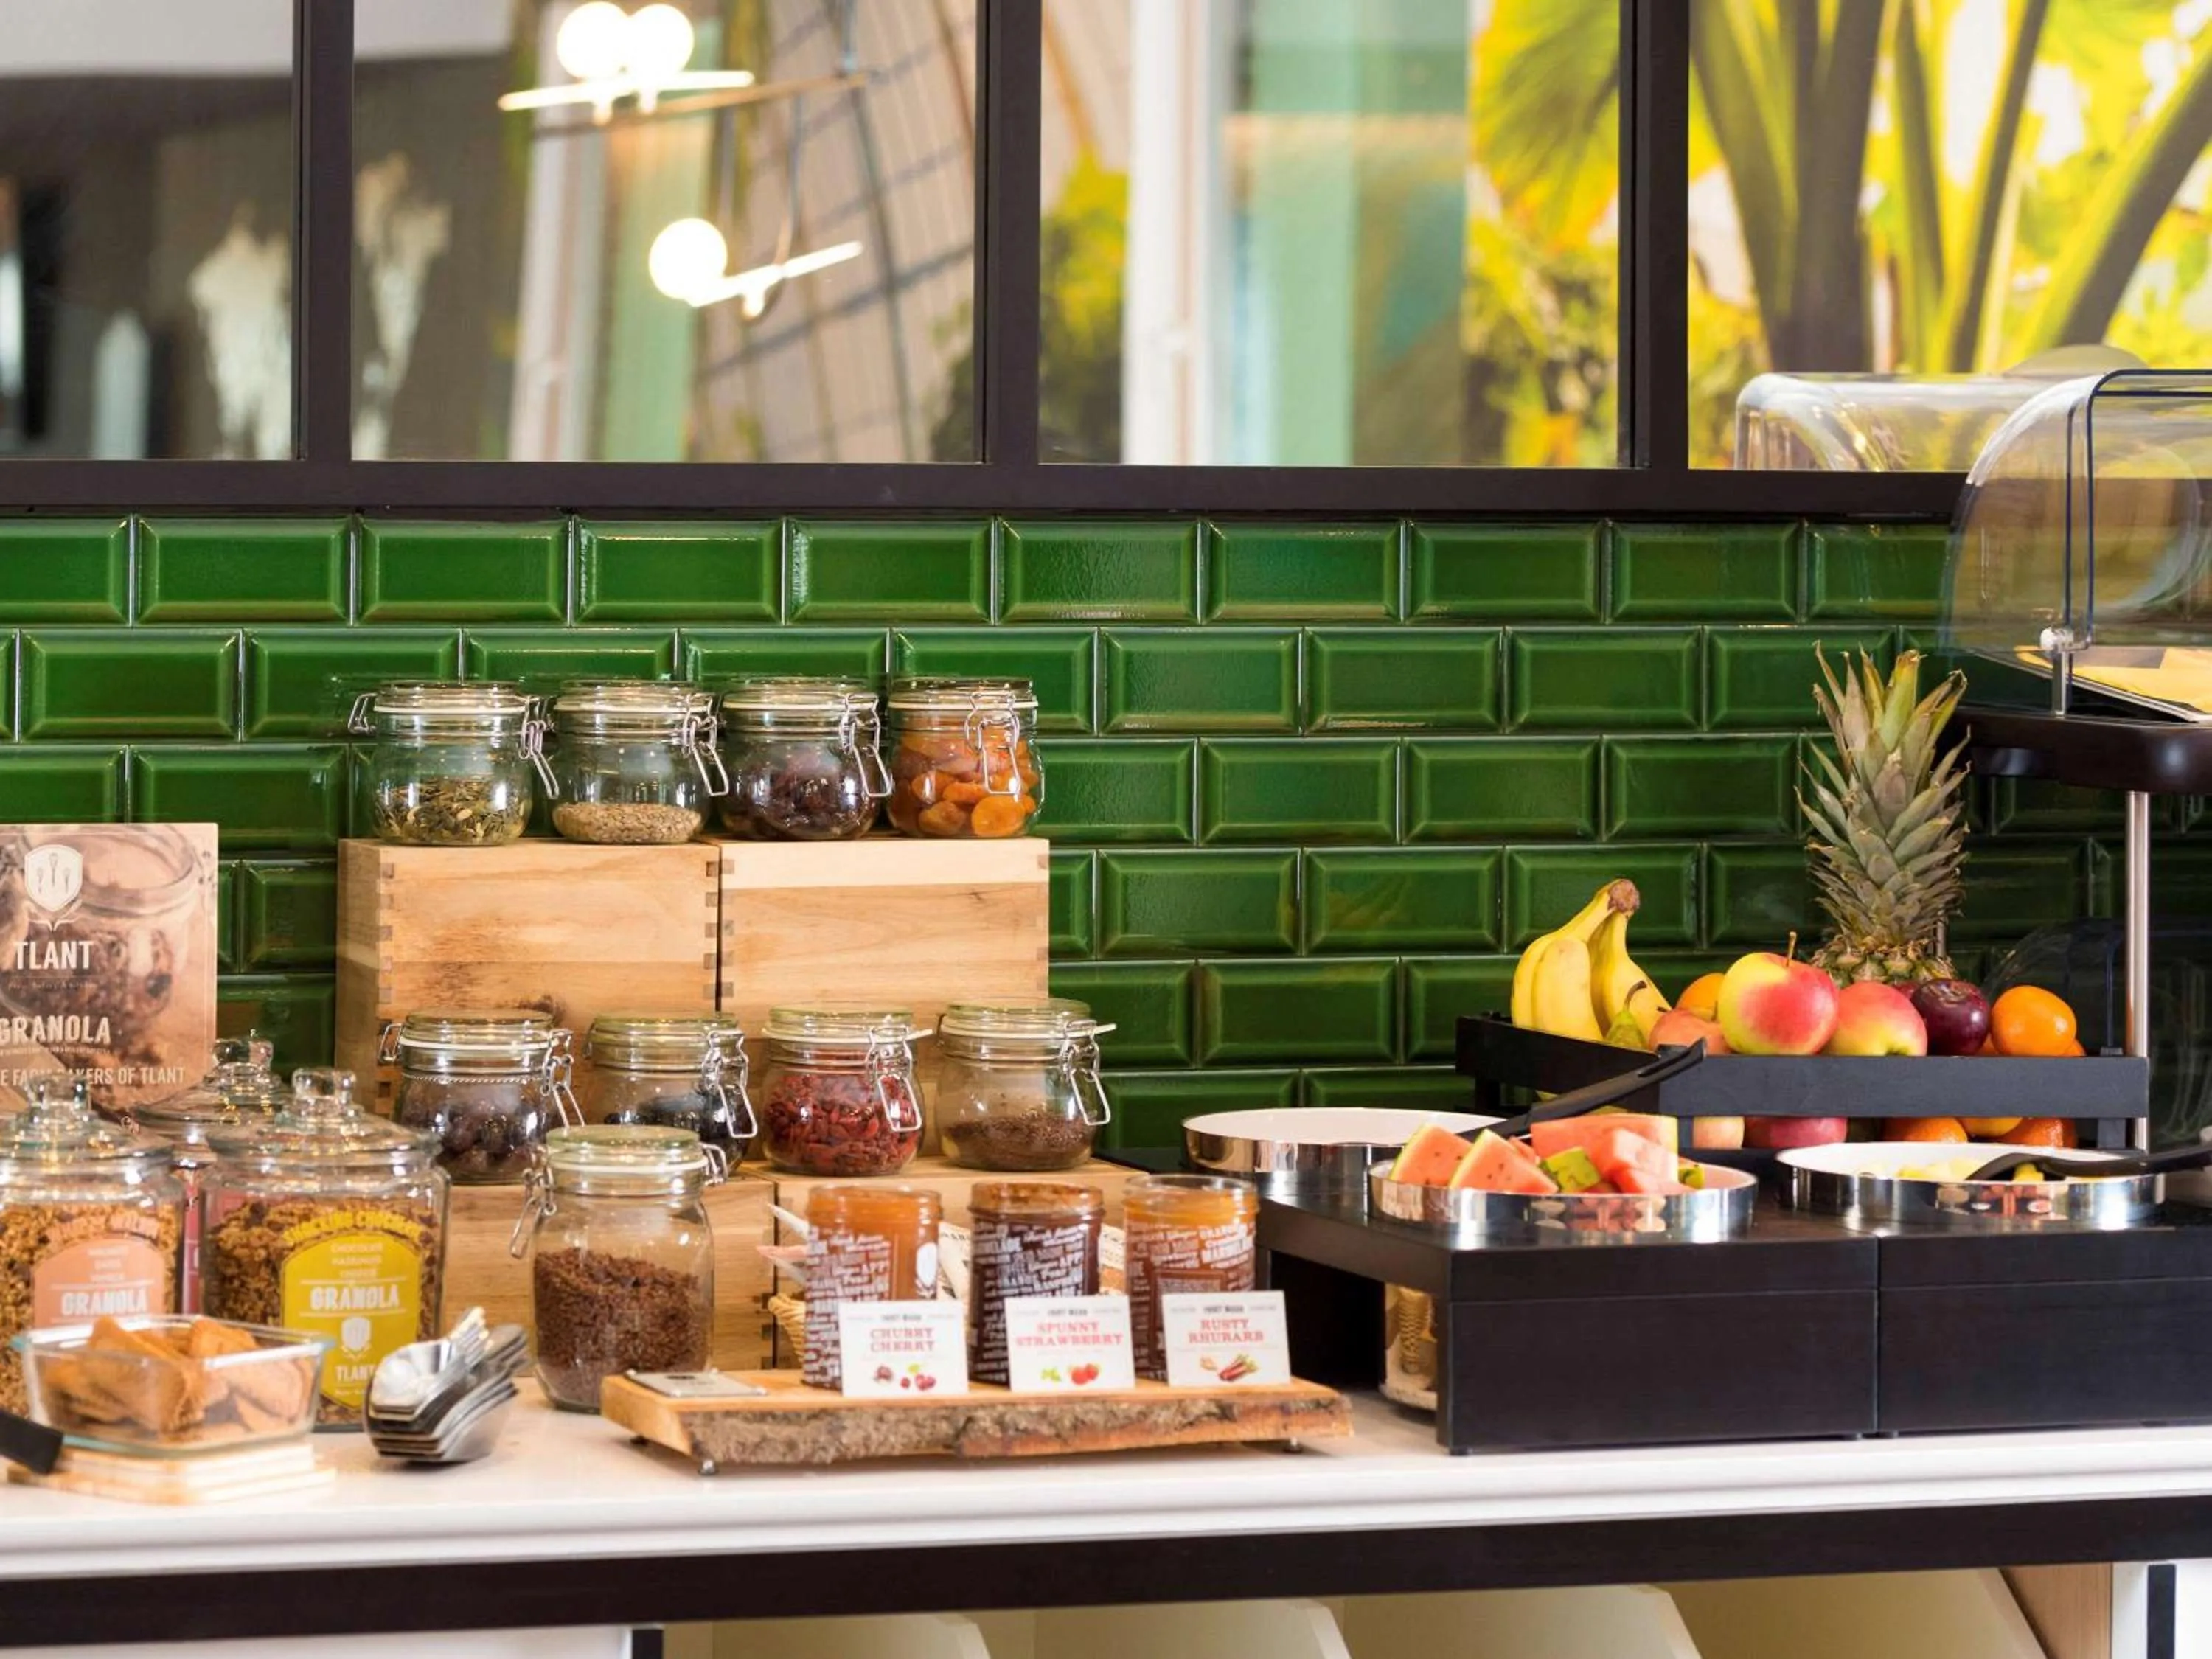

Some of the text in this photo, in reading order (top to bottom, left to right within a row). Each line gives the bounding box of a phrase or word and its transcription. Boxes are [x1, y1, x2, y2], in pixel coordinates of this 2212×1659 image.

[13, 940, 94, 970] TLANT
[0, 1015, 111, 1045] GRANOLA
[118, 1067, 136, 1085] OF
[139, 1066, 184, 1085] TLANT
[60, 1287, 147, 1317] GRANOLA
[310, 1284, 400, 1310] GRANOLA
[1200, 1318, 1249, 1330] RUSTY
[869, 1340, 935, 1352] CHERRY
[1015, 1333, 1124, 1346] STRAWBERRY
[1189, 1330, 1264, 1343] RHUBARB
